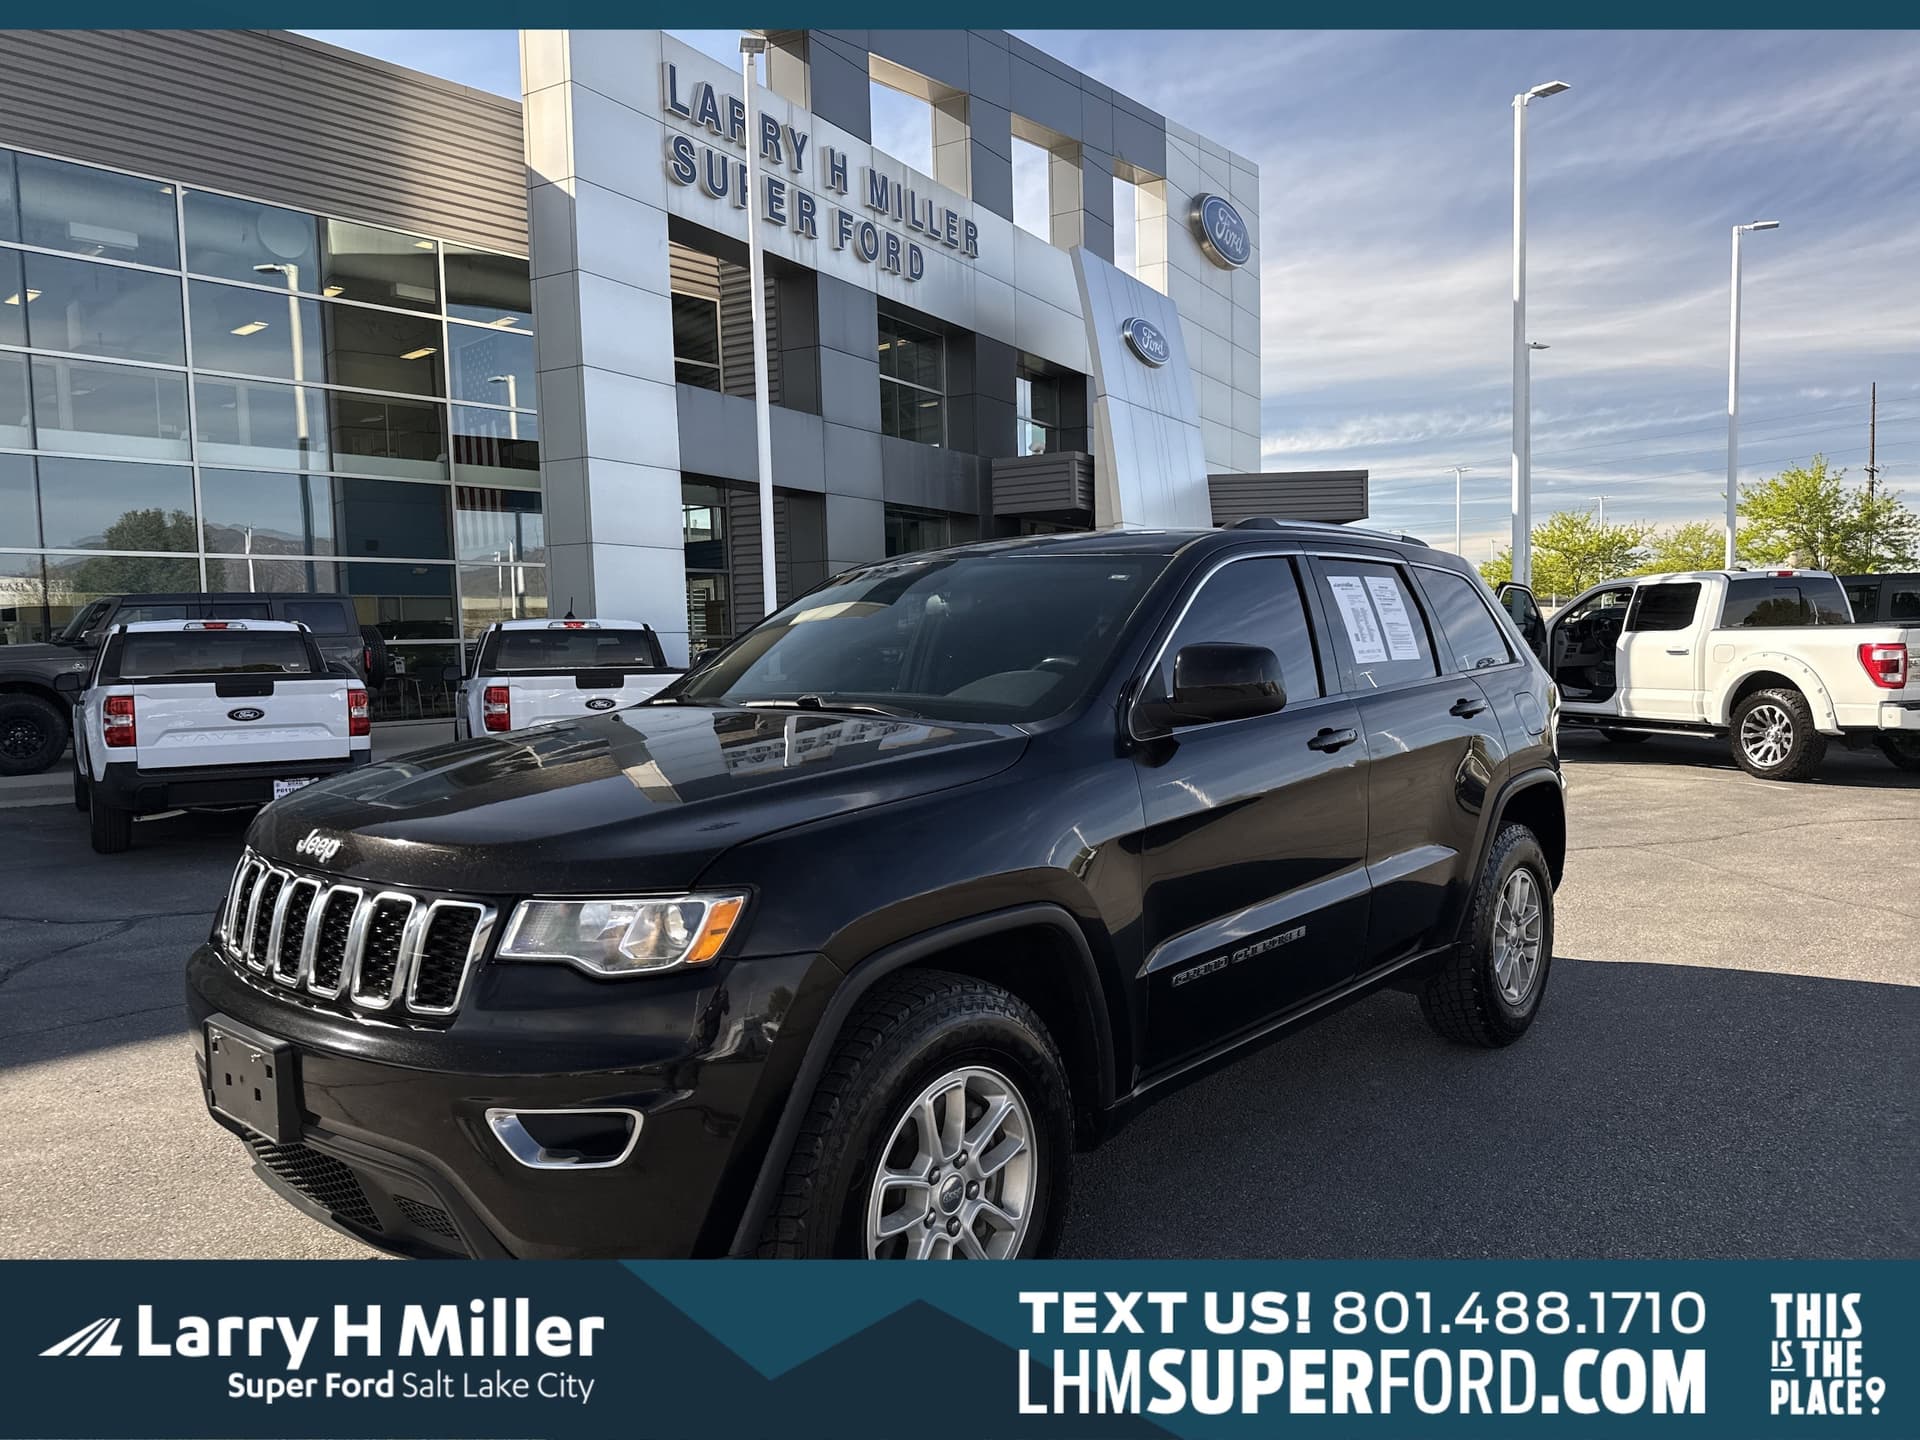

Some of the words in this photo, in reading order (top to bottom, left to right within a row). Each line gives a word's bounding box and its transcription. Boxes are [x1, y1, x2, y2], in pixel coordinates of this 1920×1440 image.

[664, 62, 809, 173] LARRY
[824, 145, 848, 194] H
[864, 166, 979, 258] MILLER
[833, 206, 924, 281] FORD
[1215, 207, 1244, 254] Ford
[1141, 326, 1164, 355] Ford
[296, 828, 341, 863] Jeep
